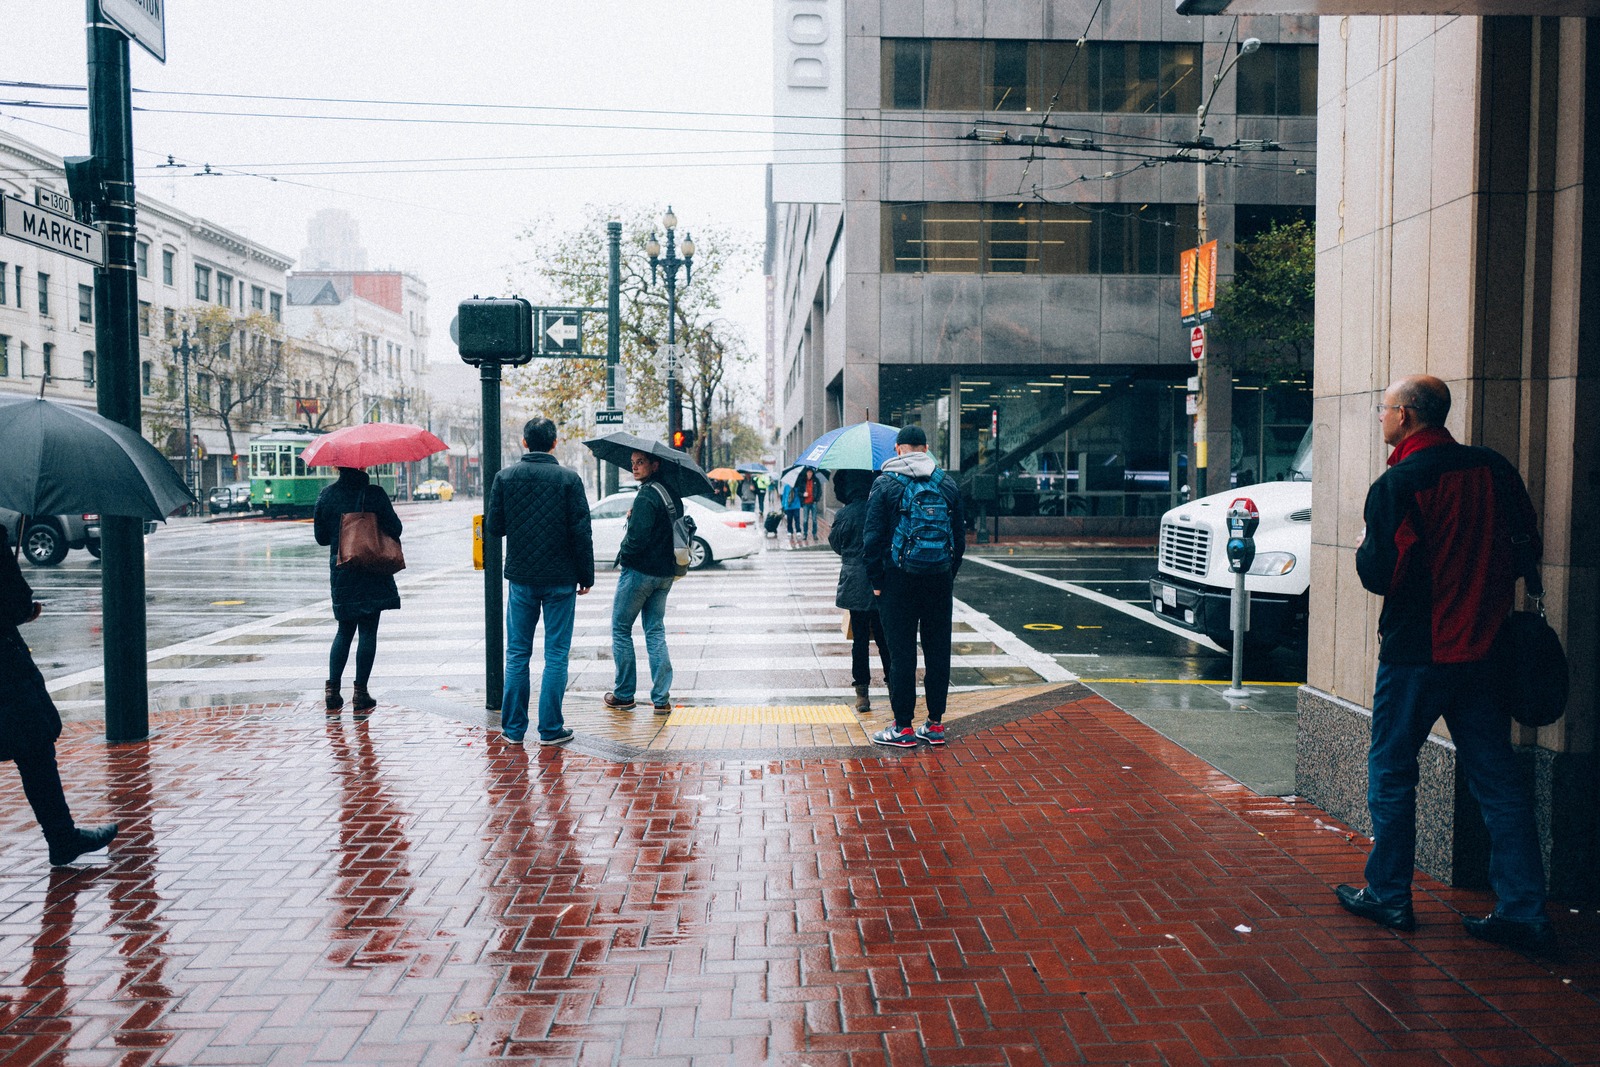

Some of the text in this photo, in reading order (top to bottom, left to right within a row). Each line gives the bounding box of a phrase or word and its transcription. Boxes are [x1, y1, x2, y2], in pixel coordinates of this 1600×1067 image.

[786, 0, 829, 88] DO
[50, 194, 70, 213] 1300
[23, 210, 92, 254] MARKET
